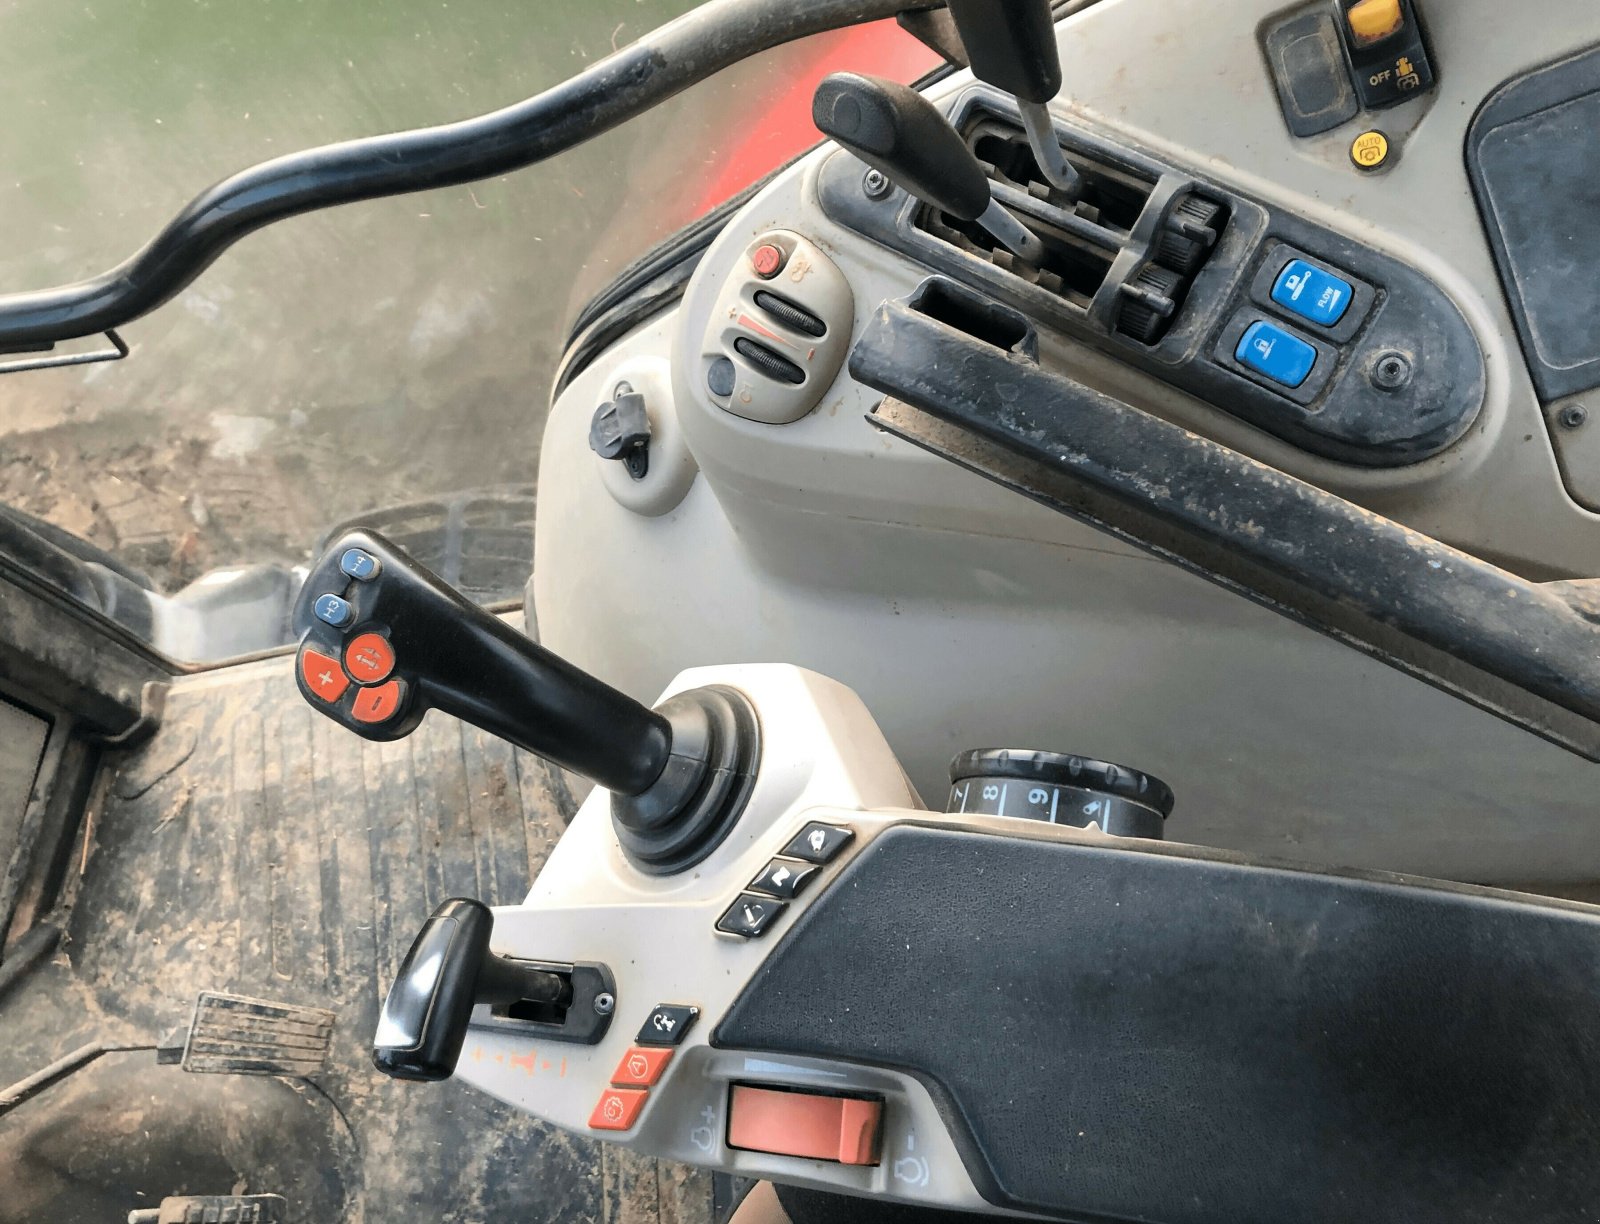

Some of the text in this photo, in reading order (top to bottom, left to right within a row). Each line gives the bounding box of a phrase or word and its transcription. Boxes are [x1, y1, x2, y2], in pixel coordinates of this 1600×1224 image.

[1369, 69, 1391, 86] OFF
[1357, 136, 1381, 148] AUTO
[1317, 286, 1334, 308] FLOW
[351, 555, 366, 573] H4
[323, 600, 340, 619] H3
[982, 785, 998, 800] 8
